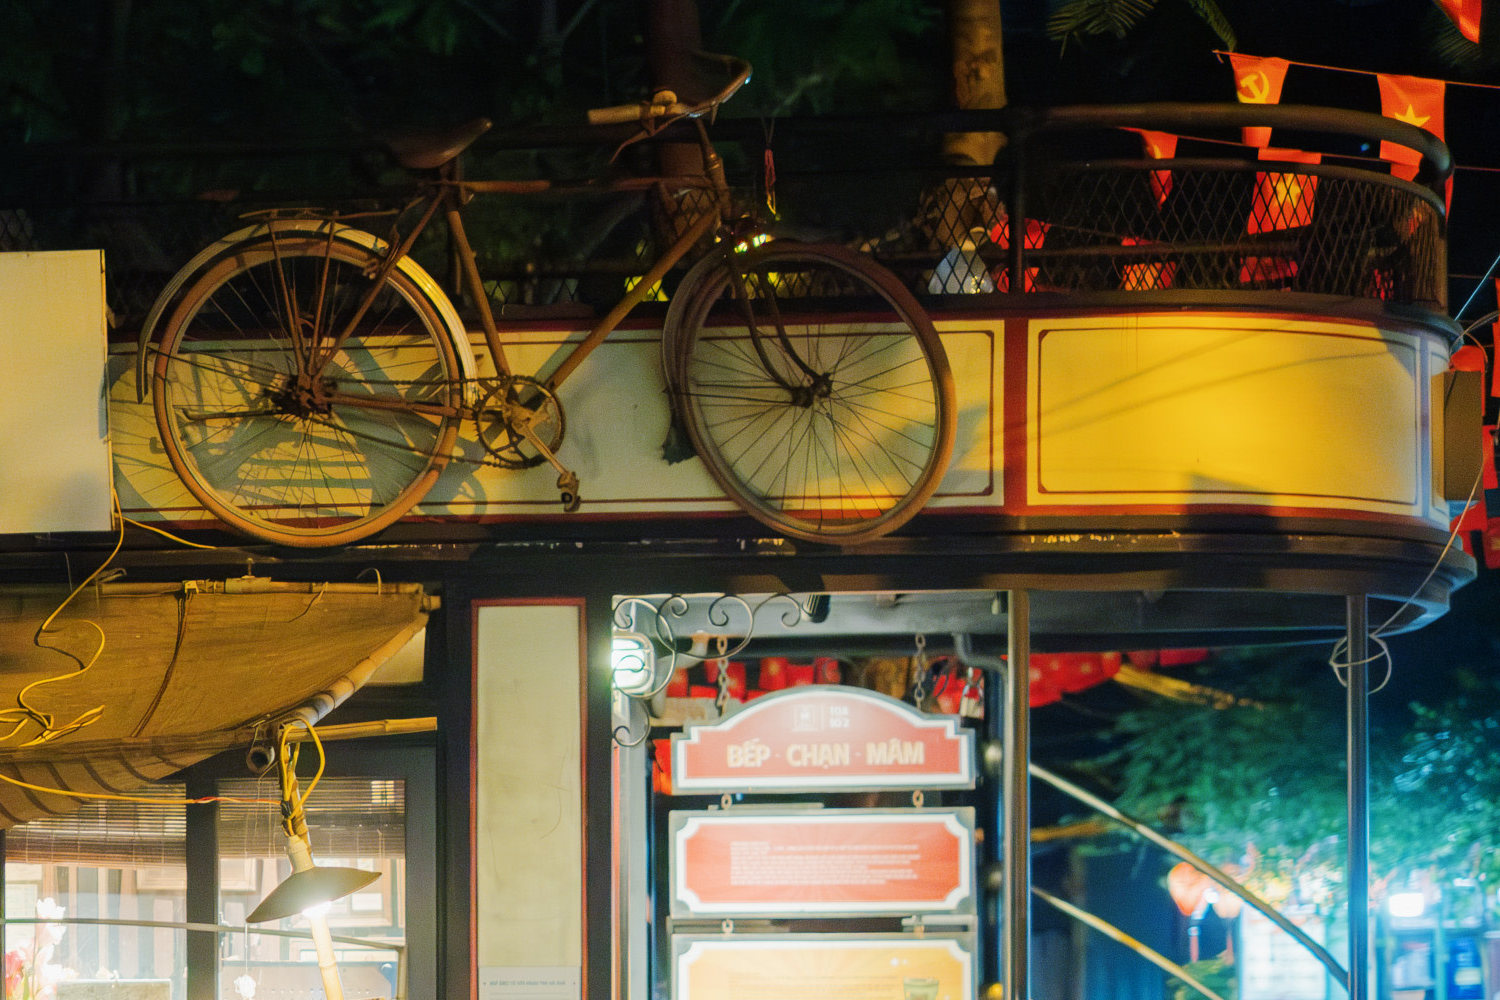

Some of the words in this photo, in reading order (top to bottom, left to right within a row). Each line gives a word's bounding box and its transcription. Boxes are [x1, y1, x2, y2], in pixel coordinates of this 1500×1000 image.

[727, 738, 771, 768] BẾP
[786, 743, 850, 769] CHẠN
[866, 741, 924, 765] MÂM
